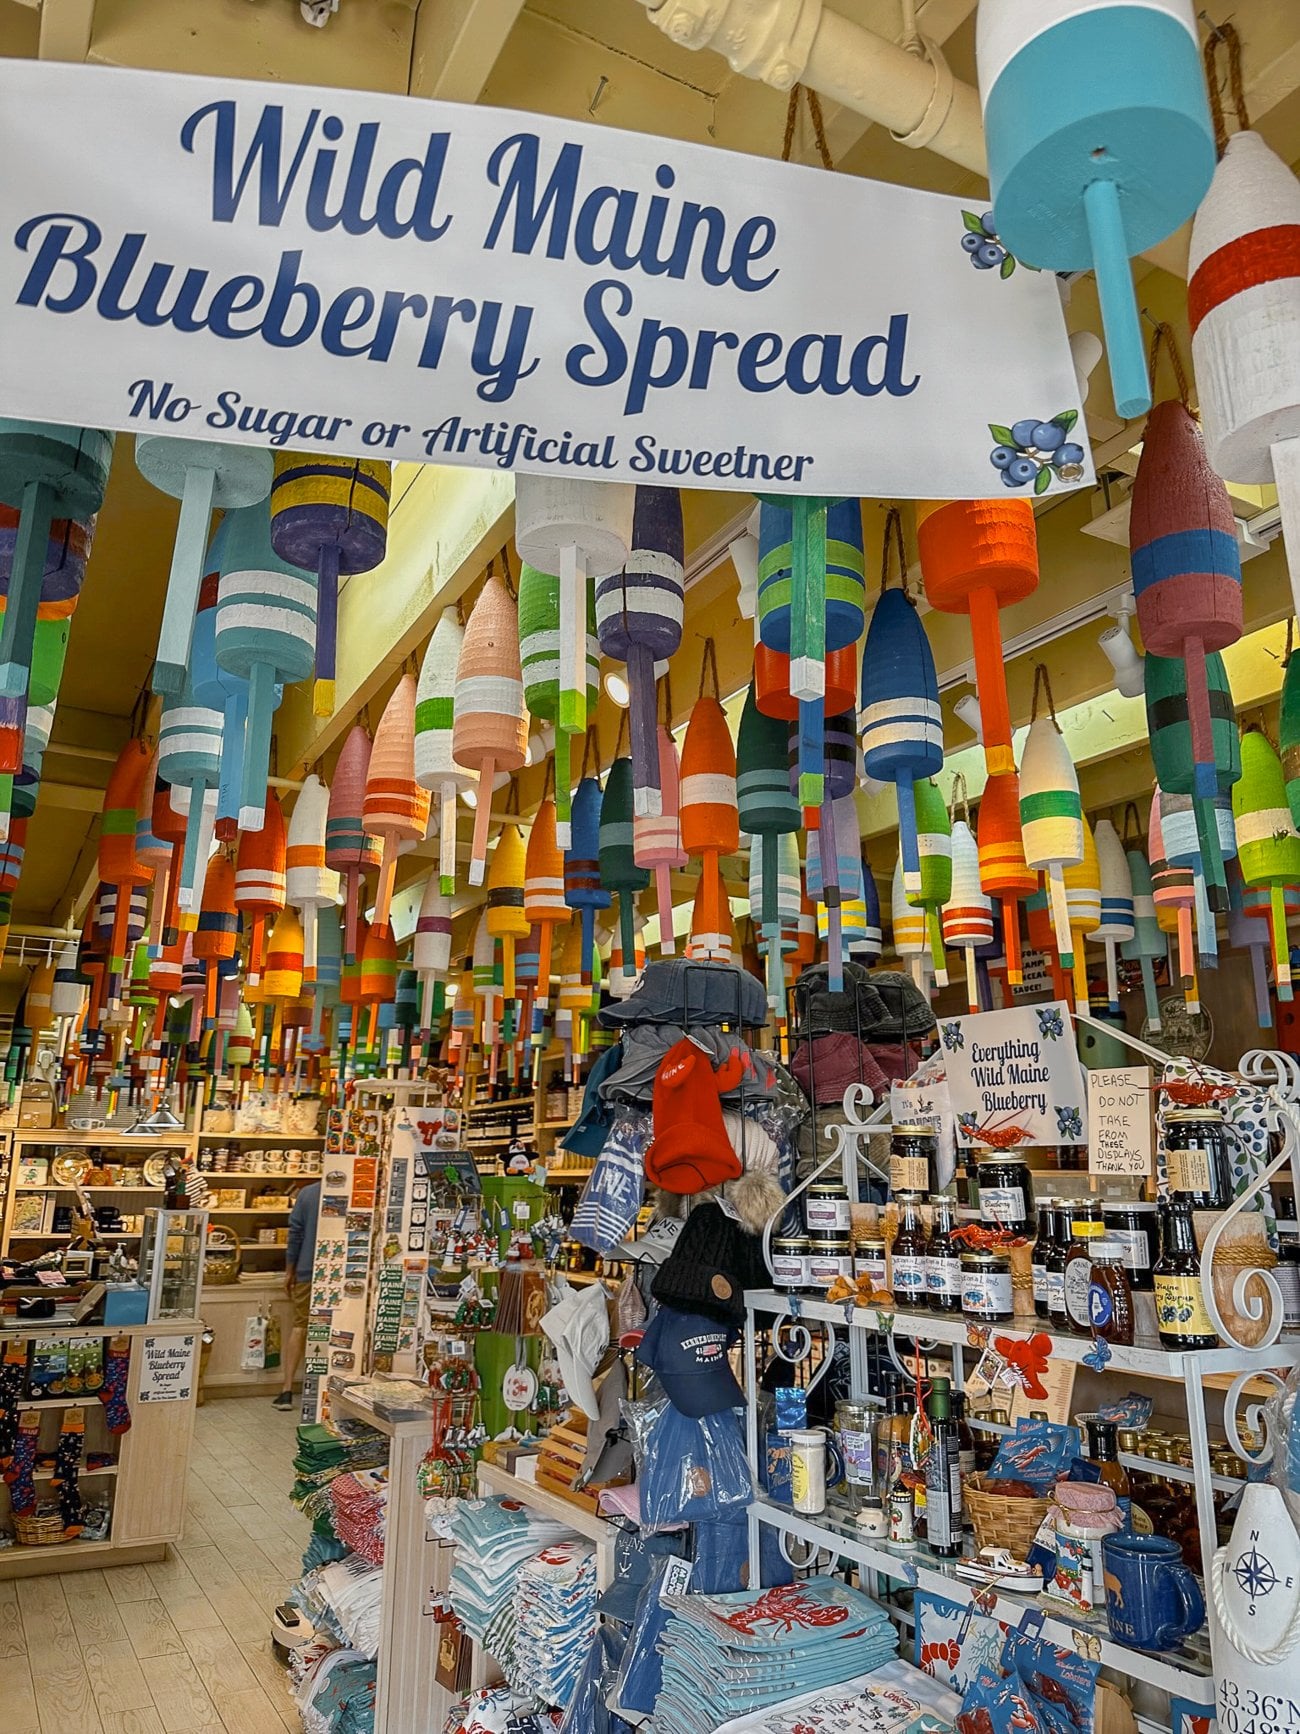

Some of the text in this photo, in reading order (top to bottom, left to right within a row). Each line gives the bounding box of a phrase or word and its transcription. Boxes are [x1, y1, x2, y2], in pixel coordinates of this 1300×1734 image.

[180, 99, 780, 292] Wild Maine
[14, 212, 921, 416] Blueberry Spread
[127, 378, 814, 482] No Sugar or Artificial Sweetner
[972, 1039, 1041, 1066] Everything
[971, 1064, 1050, 1087] Wild Maine
[1091, 1074, 1134, 1088] PLEASE
[982, 1091, 1048, 1115] Blueberry
[1099, 1093, 1145, 1108] DO NOT
[1098, 1115, 1131, 1127] TAKE
[1098, 1130, 1128, 1140] FROM
[1100, 1140, 1125, 1149] THESE
[1097, 1148, 1142, 1161] DISPLAYS
[1096, 1160, 1145, 1173] THANK YOU
[145, 1348, 191, 1360] Wild Maine
[148, 1360, 186, 1372] Blueberry
[152, 1371, 181, 1383] Spread
[1249, 1530, 1260, 1542] N
[1285, 1577, 1294, 1589] E
[1247, 1604, 1257, 1616] S
